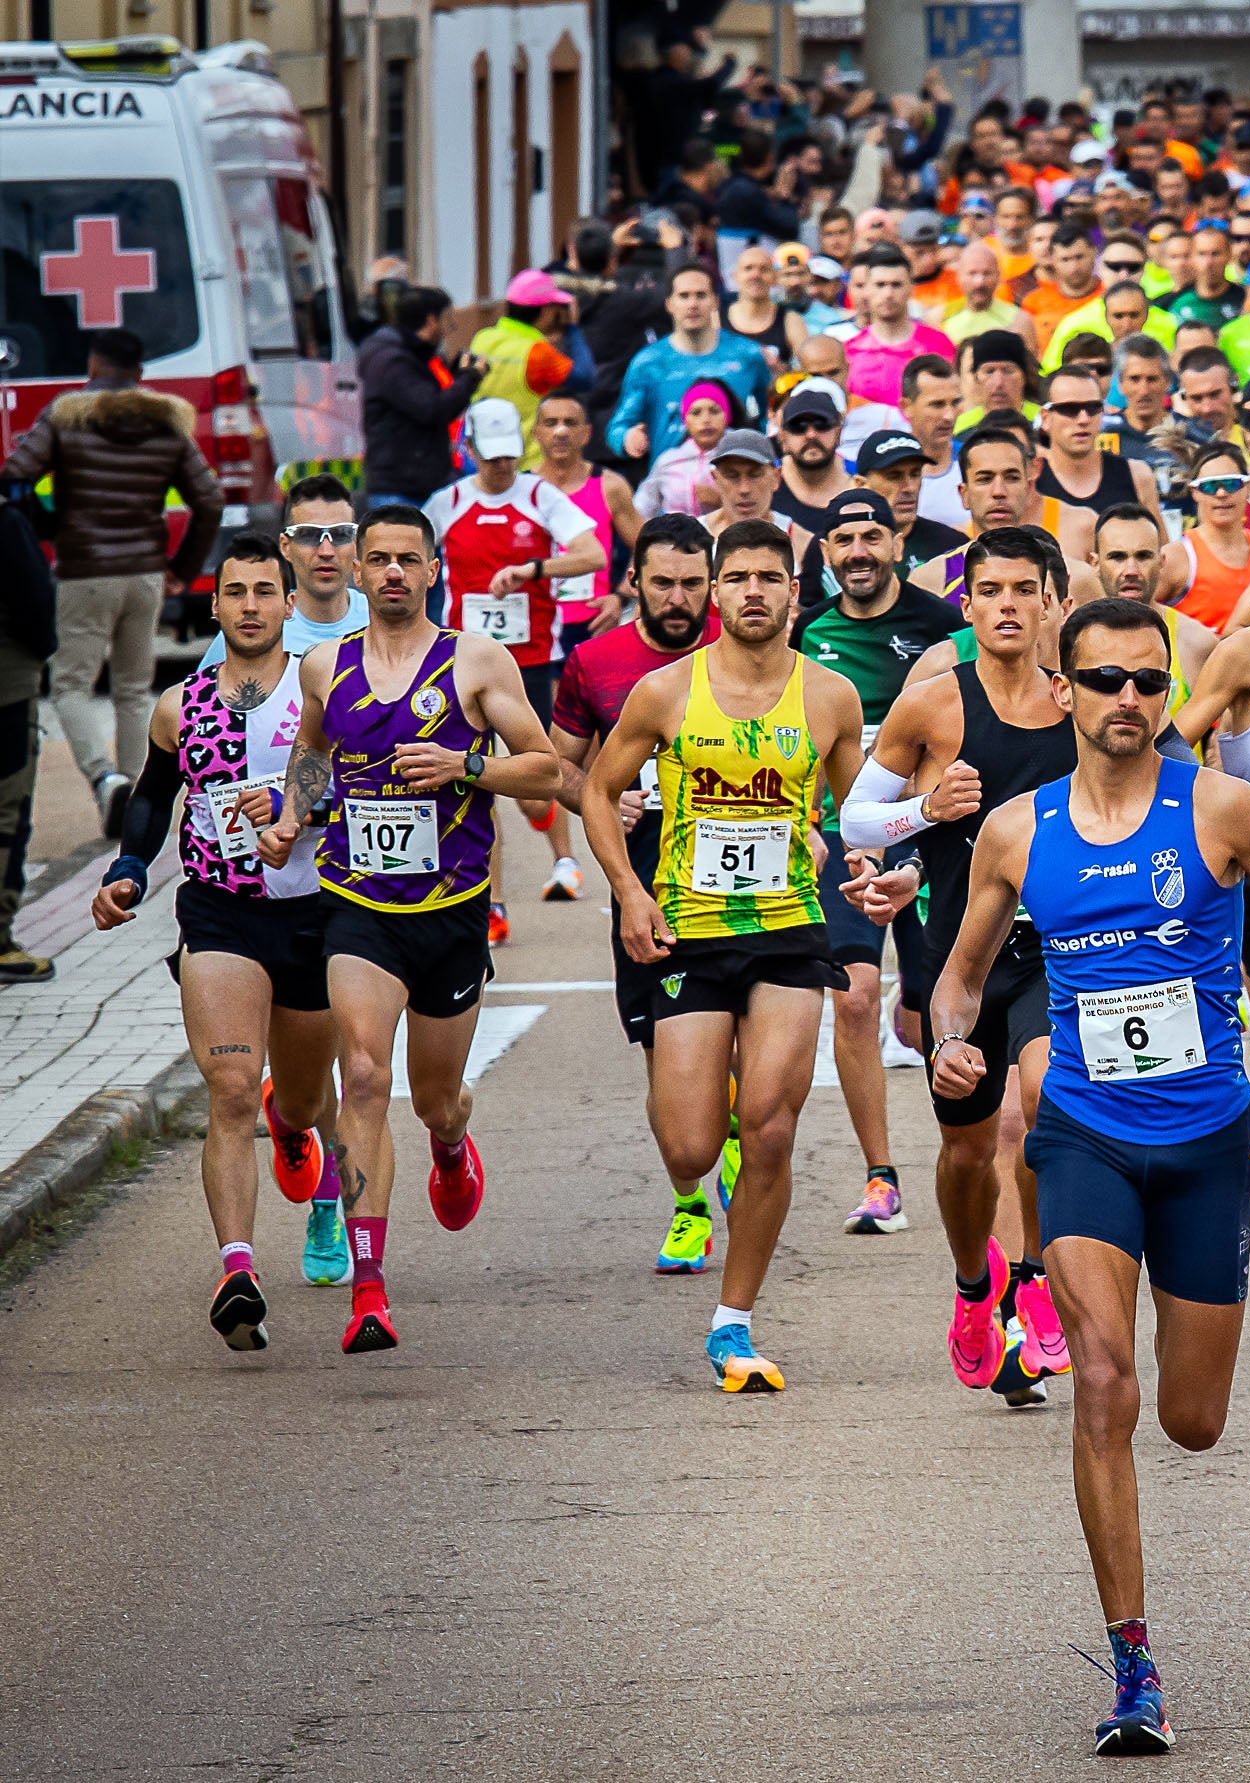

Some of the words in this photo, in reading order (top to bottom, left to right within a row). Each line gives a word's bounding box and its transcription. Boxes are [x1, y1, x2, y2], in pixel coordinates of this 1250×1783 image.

[482, 611, 506, 629] 73
[361, 823, 415, 851] 107
[720, 844, 755, 871] 51
[1081, 999, 1097, 1007] XVII
[1097, 997, 1122, 1005] MEDIA
[1124, 990, 1165, 1002] MARATÓN
[1096, 1007, 1125, 1016] CIUDAD
[1126, 1001, 1164, 1013] RODRIGO
[1123, 1016, 1149, 1051] 6
